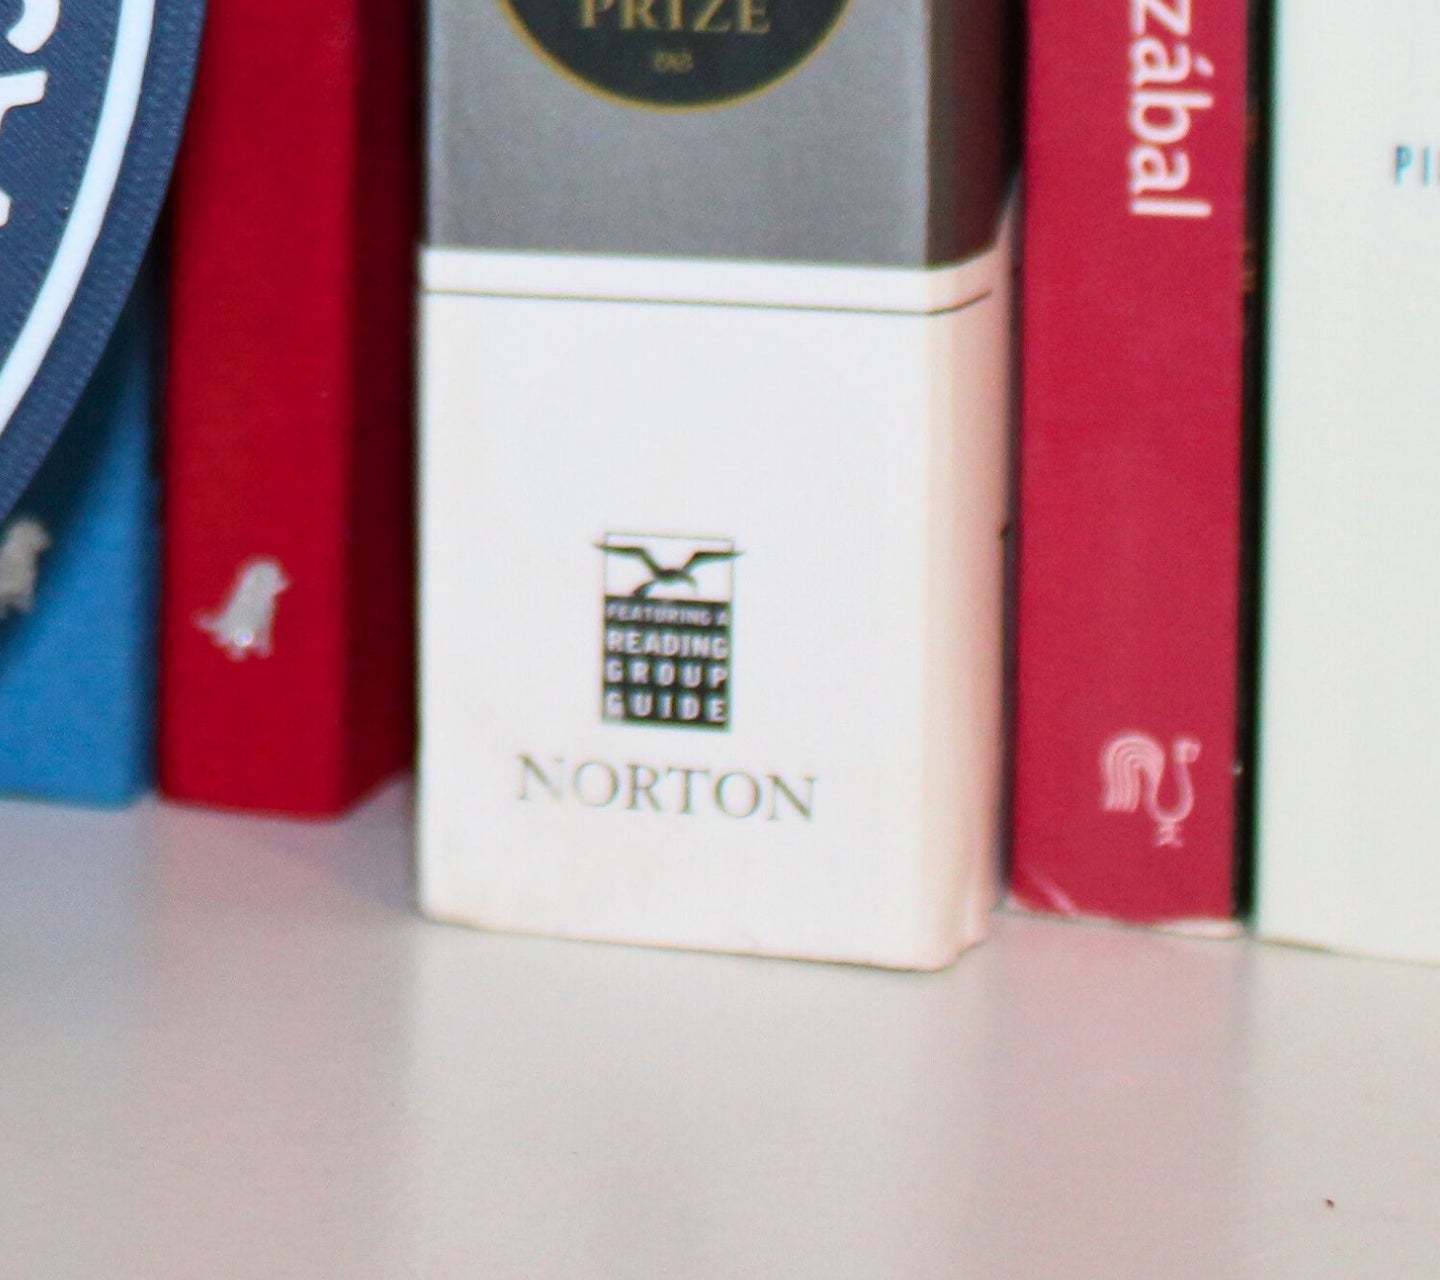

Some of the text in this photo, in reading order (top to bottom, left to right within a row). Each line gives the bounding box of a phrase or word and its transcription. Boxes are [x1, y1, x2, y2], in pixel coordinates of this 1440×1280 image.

[607, 630, 729, 660] READING
[606, 659, 728, 689] GROUP
[604, 692, 729, 723] GUIDE
[515, 753, 817, 822] NORTON
